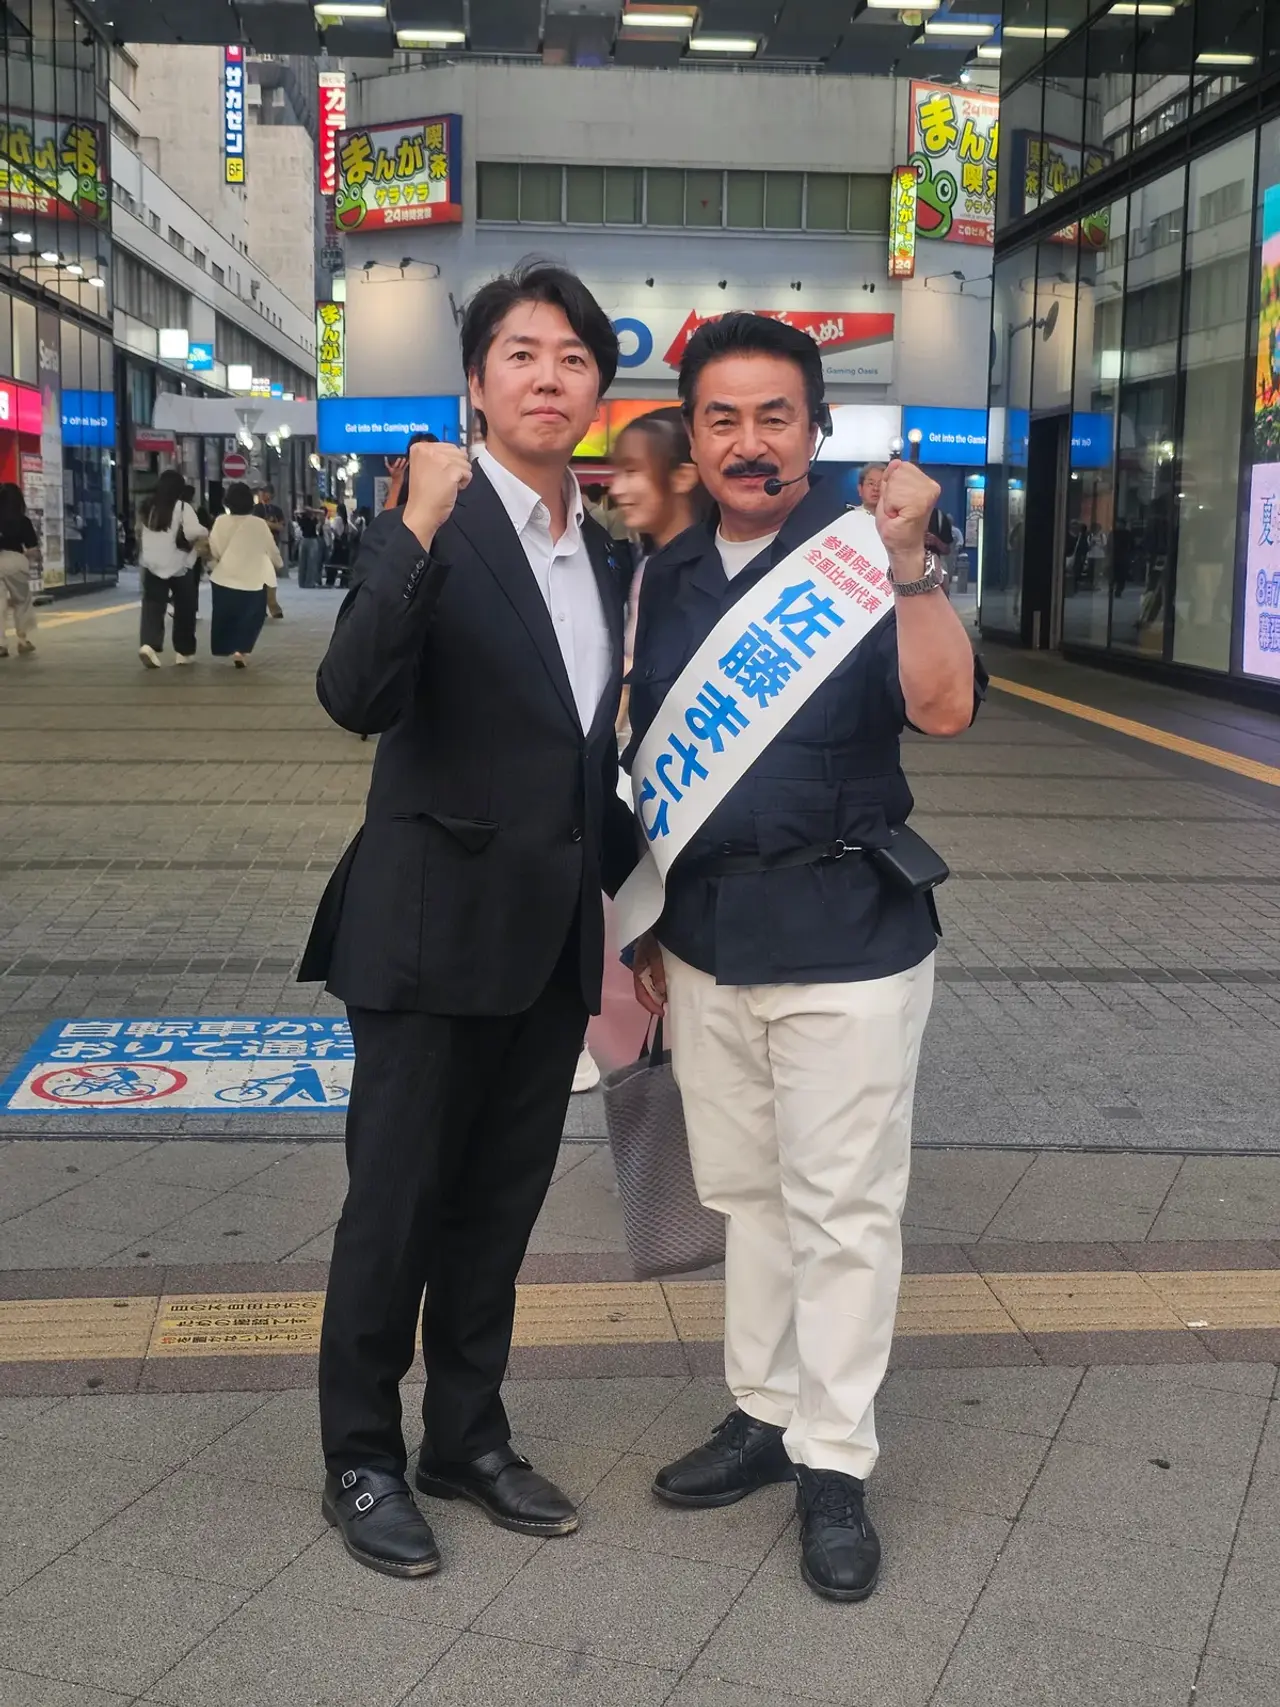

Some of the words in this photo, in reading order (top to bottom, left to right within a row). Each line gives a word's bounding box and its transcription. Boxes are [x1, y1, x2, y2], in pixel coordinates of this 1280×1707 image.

[228, 163, 242, 177] 6F
[340, 134, 424, 186] まんが
[898, 173, 915, 224] まんが
[895, 261, 911, 270] 24
[320, 304, 342, 361] まんが
[826, 366, 856, 376] Gaming
[857, 366, 879, 375] Oasis
[345, 423, 358, 433] Get
[371, 423, 383, 432] the
[384, 422, 410, 434] Gaming
[410, 422, 429, 432] Oasis
[929, 432, 942, 442] Get
[955, 434, 966, 443] the
[1258, 494, 1276, 546] 夏
[804, 548, 882, 614] 全国比例代表
[822, 535, 893, 598] 参議院議員
